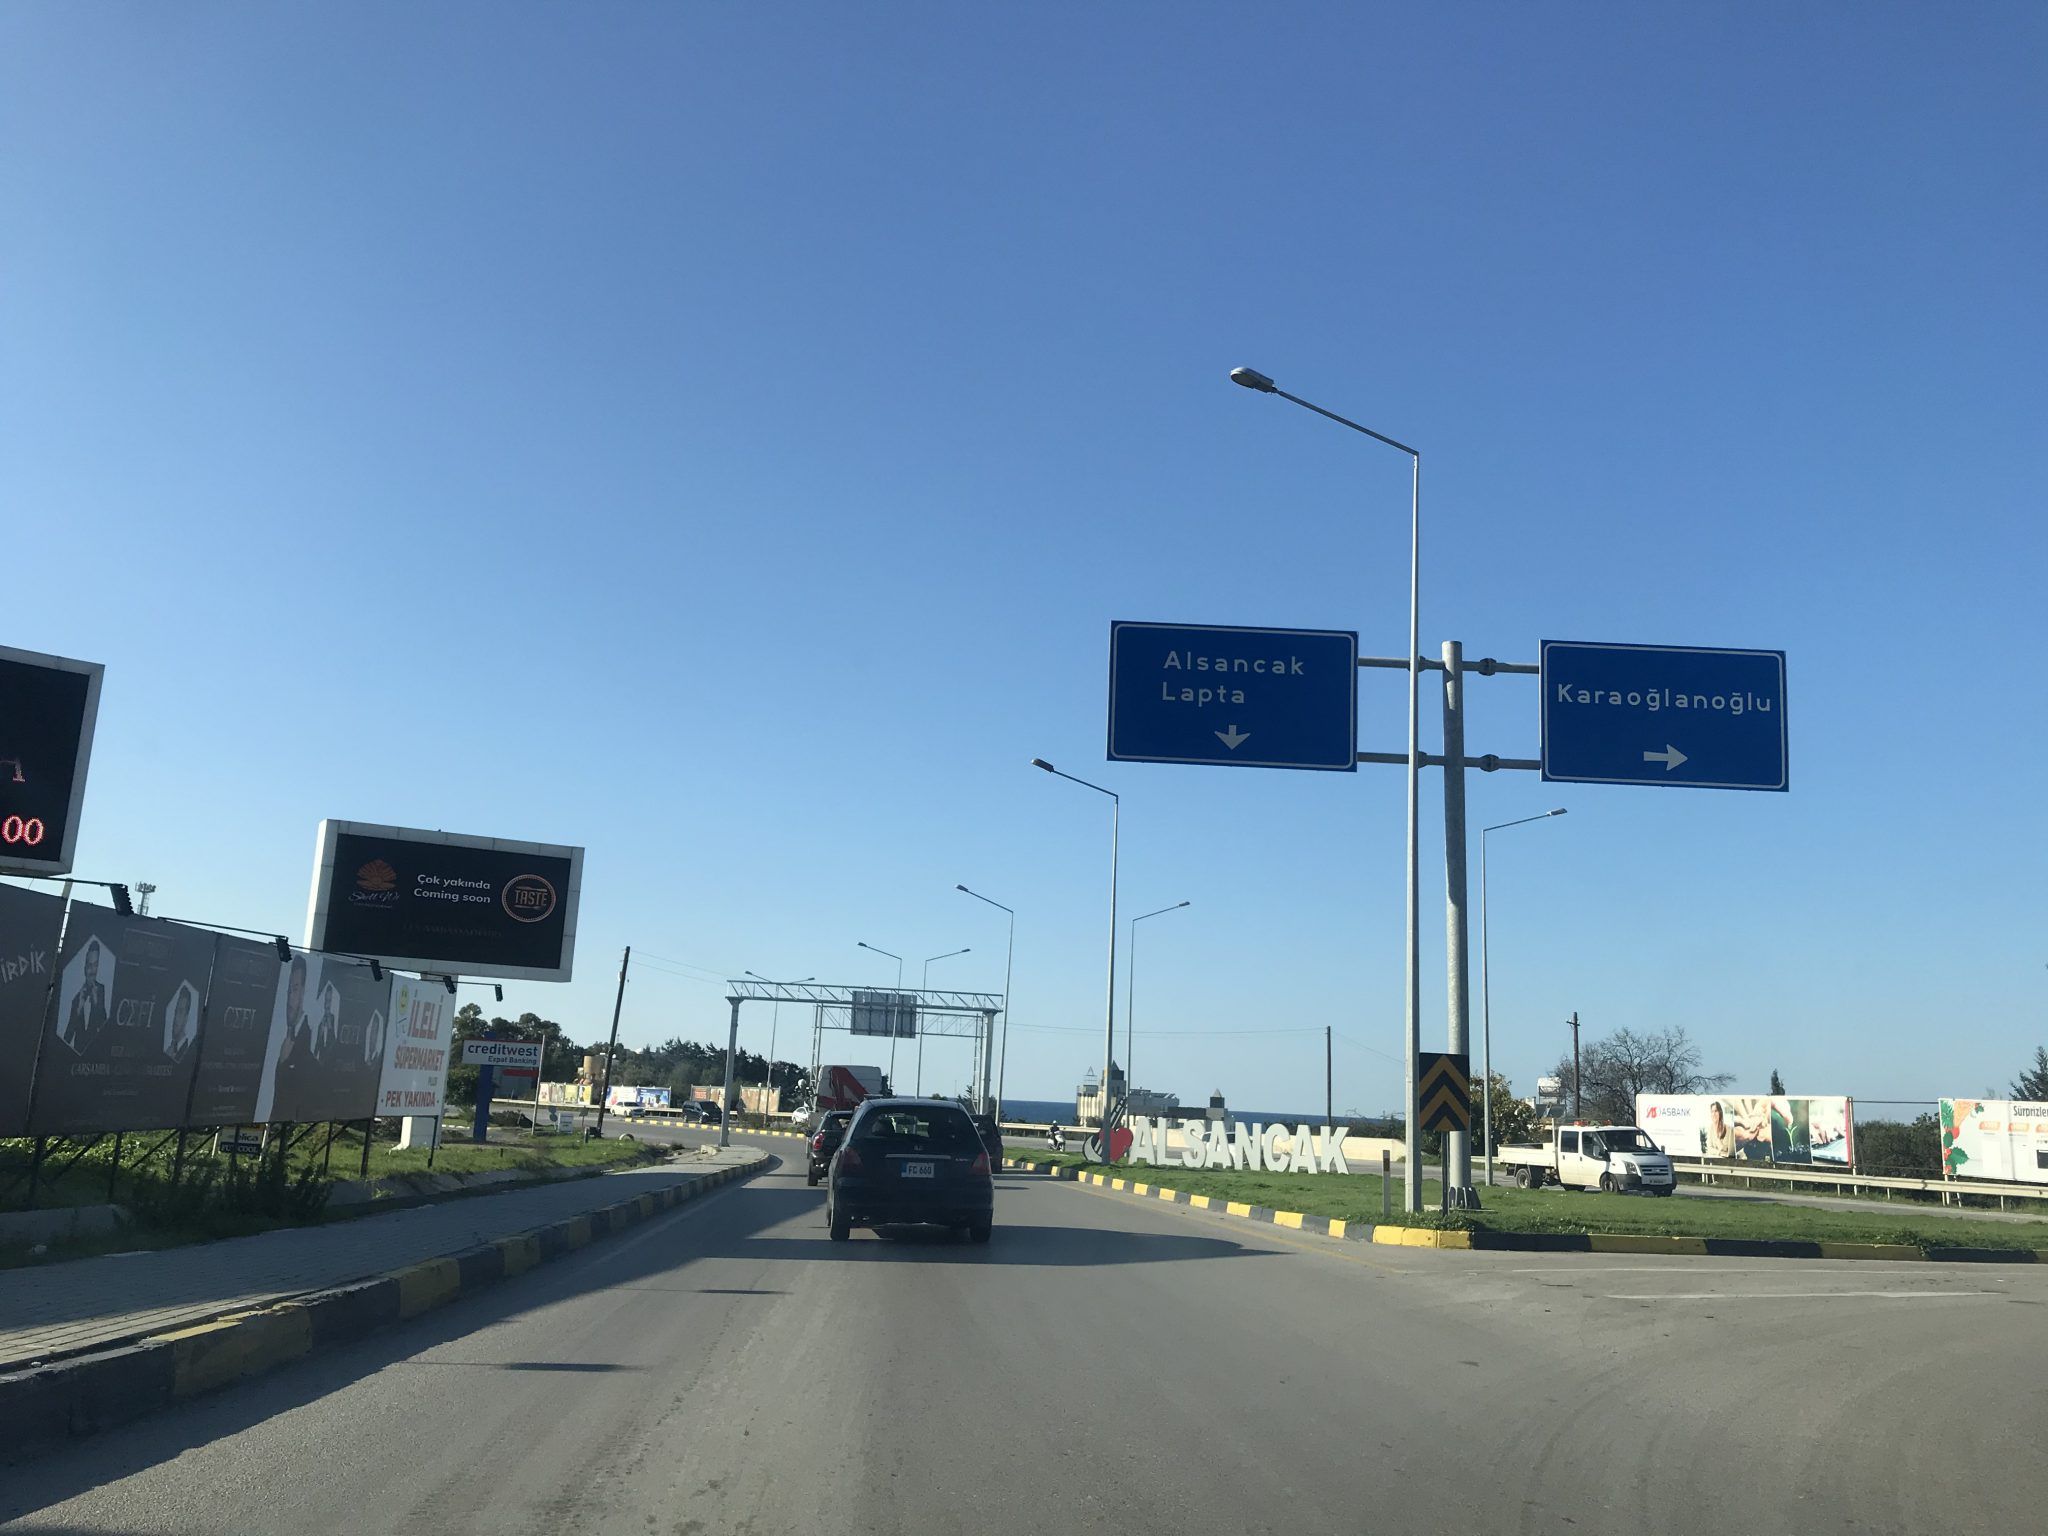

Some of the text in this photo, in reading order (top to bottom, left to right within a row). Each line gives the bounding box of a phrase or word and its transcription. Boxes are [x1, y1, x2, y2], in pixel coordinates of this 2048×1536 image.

[1163, 650, 1304, 675] Alsancak
[1161, 681, 1245, 707] Lapta
[1557, 683, 1771, 715] Karaoğlanoğlu
[417, 873, 491, 890] Çok yakında
[413, 887, 459, 904] Coming
[462, 892, 491, 904] soon
[514, 888, 548, 907] TASTE
[467, 1043, 539, 1057] creditwest
[509, 1056, 537, 1066] Banking
[385, 1090, 436, 1108] PEK YAKINDA
[1659, 1107, 1691, 1117] ASBANK
[1128, 1115, 1350, 1175] ALSANCAK
